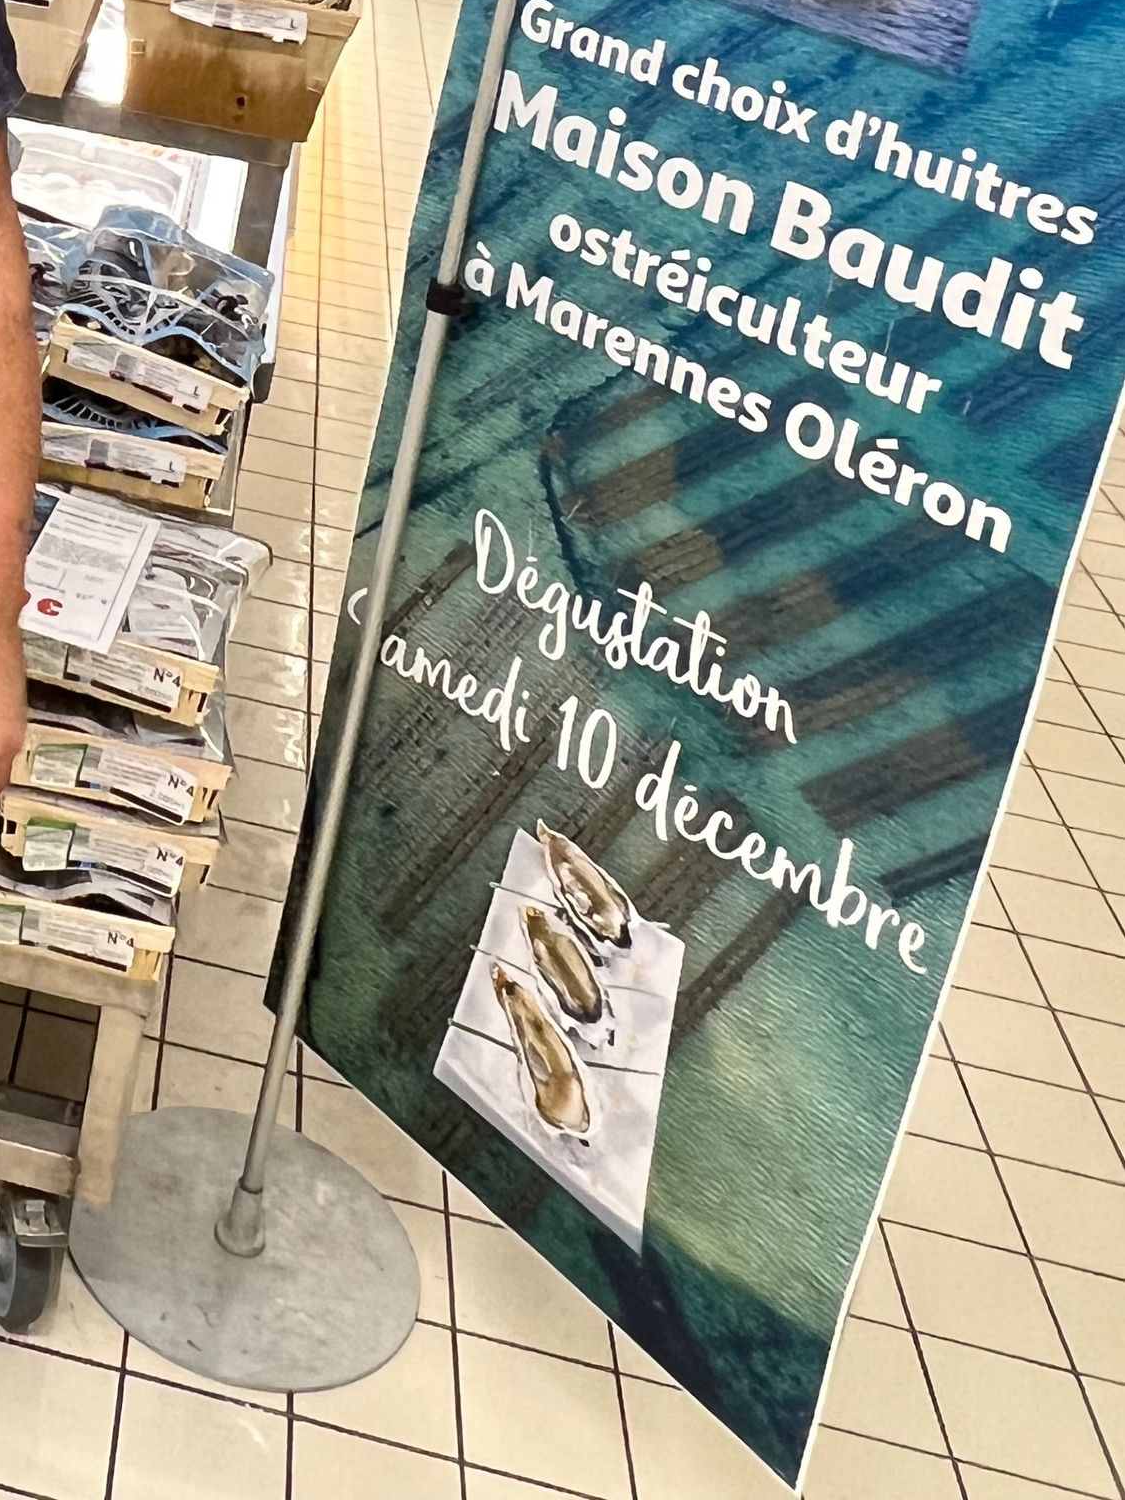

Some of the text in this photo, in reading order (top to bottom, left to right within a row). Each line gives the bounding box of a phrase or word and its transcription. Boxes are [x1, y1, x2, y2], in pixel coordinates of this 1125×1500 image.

[492, 68, 1086, 371] Maison Baudit
[671, 56, 819, 145] choix
[823, 108, 1100, 246] d'huitres
[463, 240, 1014, 555] à Marennes Oléron
[548, 212, 944, 415] ostréiculteur
[473, 507, 799, 746] Dégustation
[556, 694, 619, 791] 10
[634, 739, 930, 977] décembre
